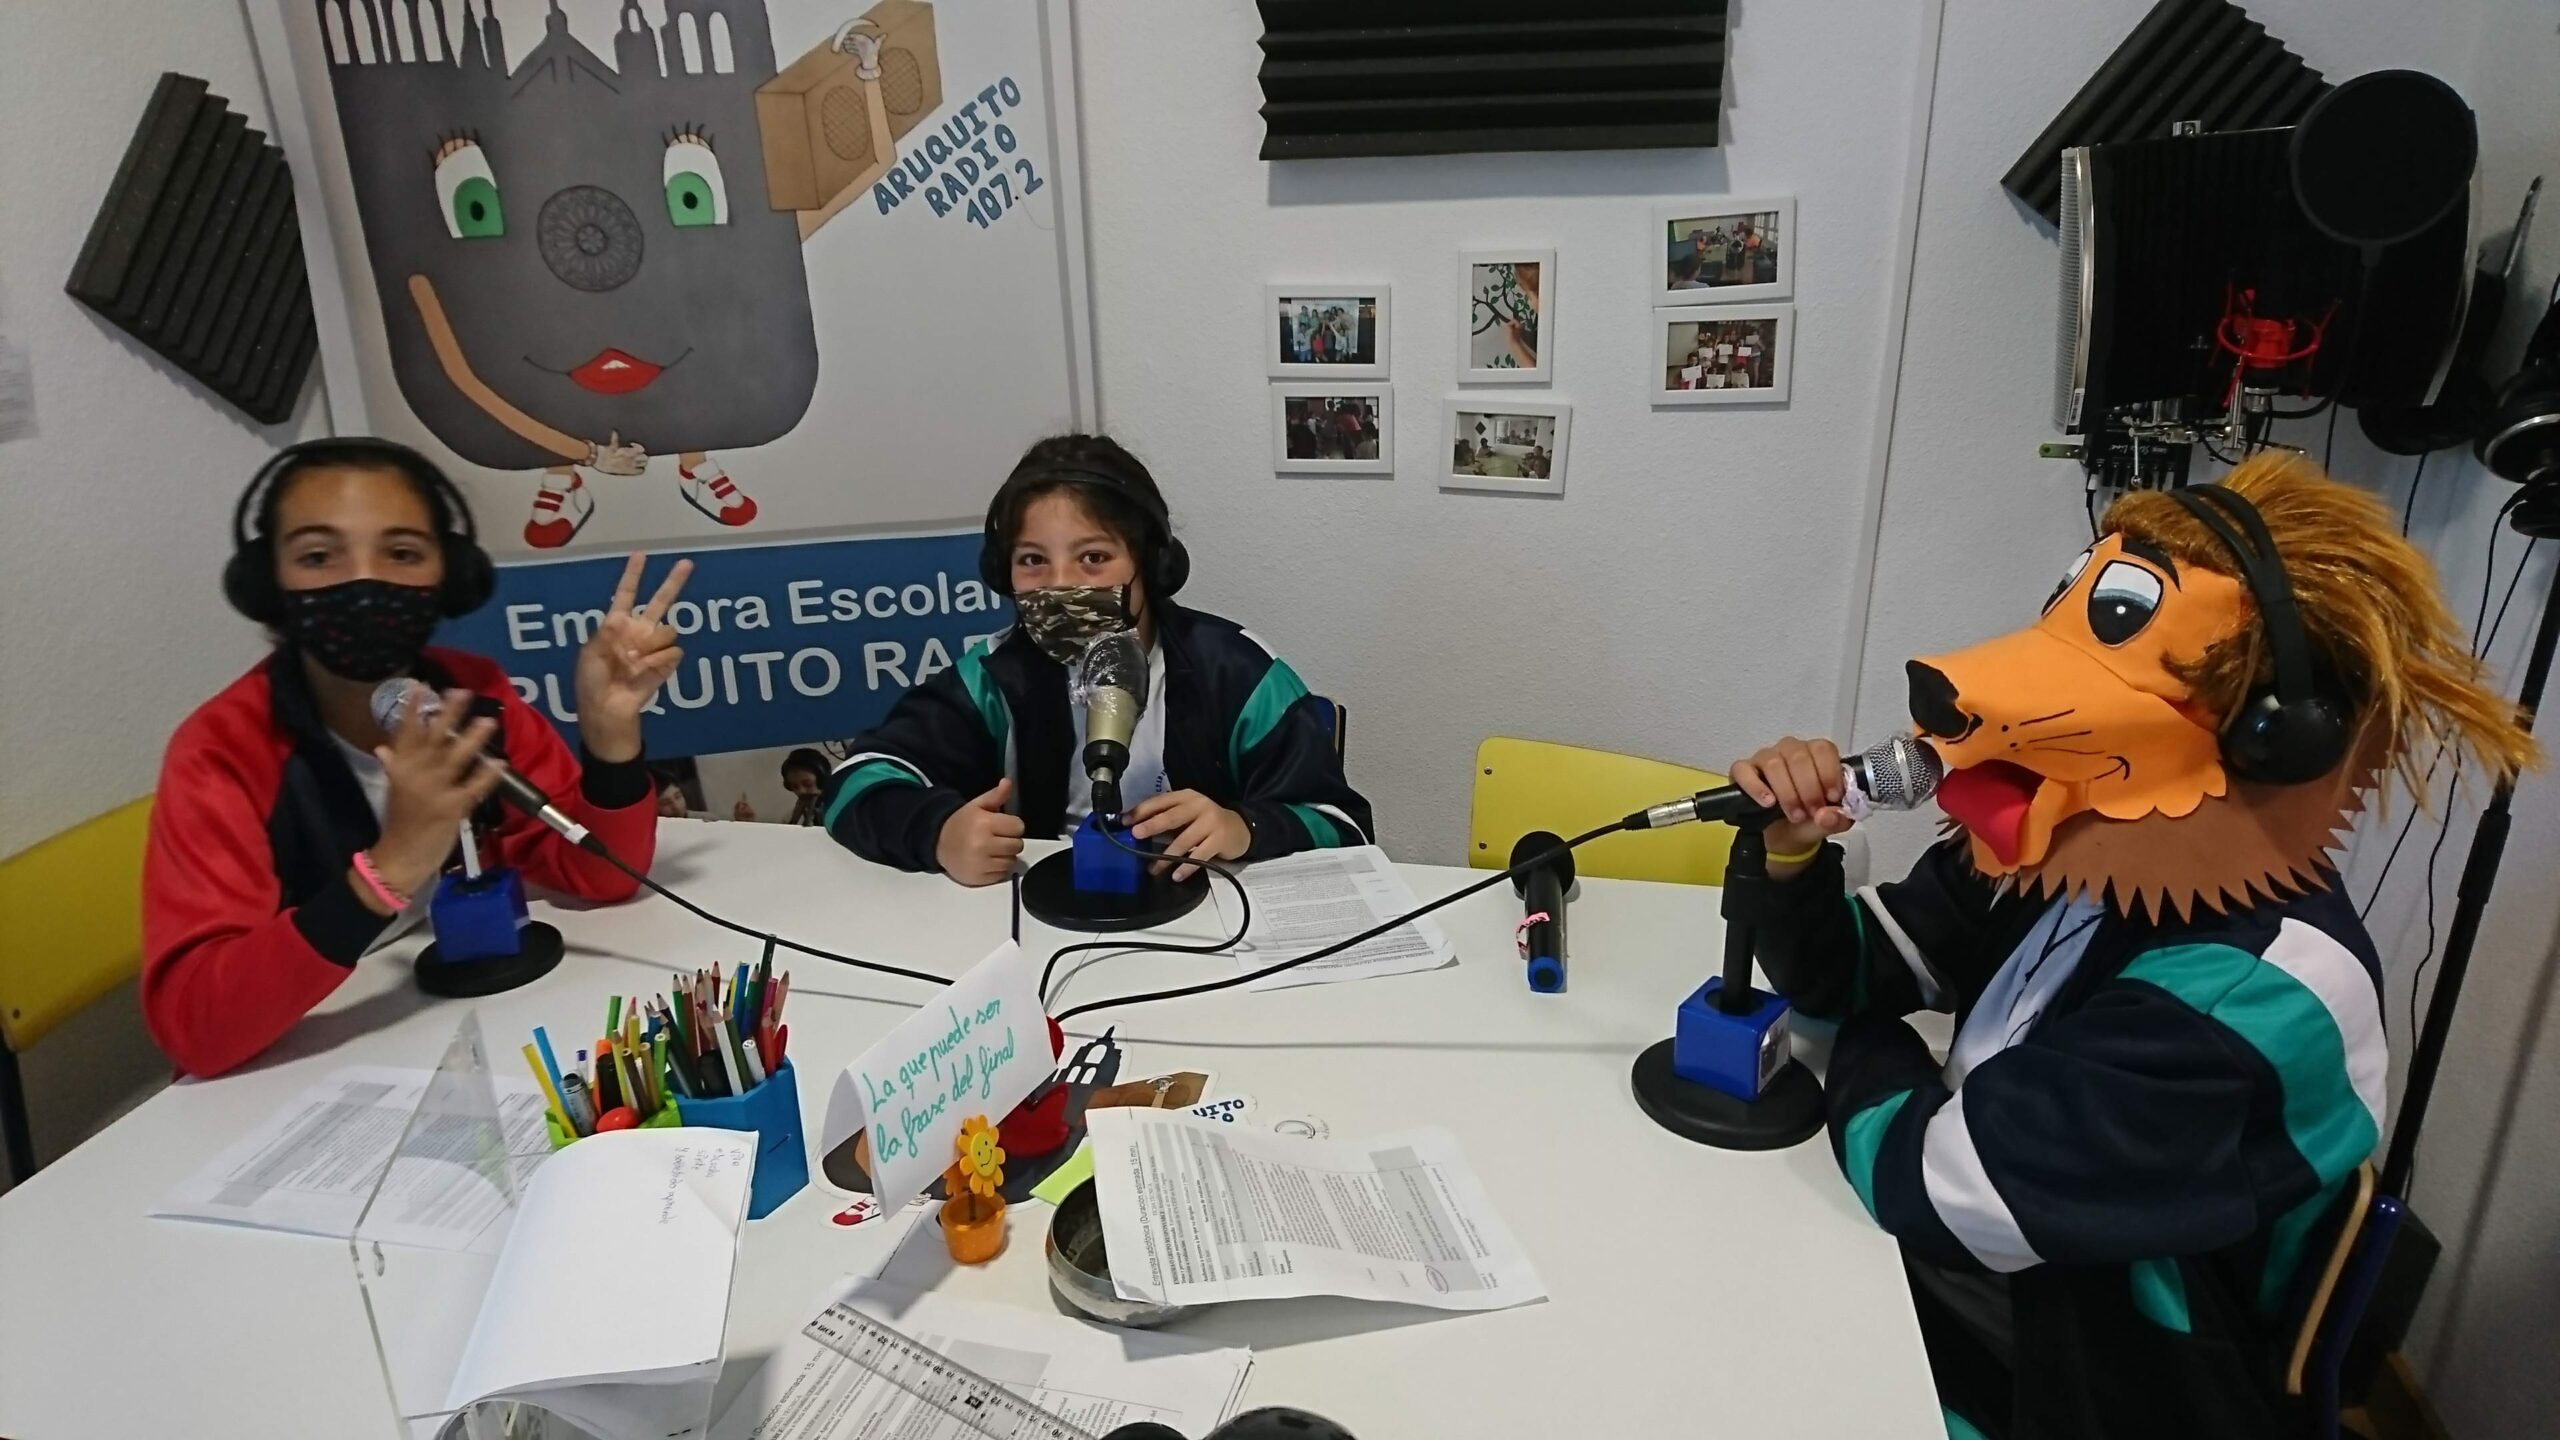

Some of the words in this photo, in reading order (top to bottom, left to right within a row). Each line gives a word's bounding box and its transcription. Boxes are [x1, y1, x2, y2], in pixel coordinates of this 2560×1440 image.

[873, 76, 1021, 215] ARUQUITO
[924, 124, 1017, 218] RADIO
[967, 158, 1044, 229] 107.2
[506, 595, 770, 650] Emora
[862, 1072, 896, 1114] La
[900, 1052, 926, 1100] que
[929, 1005, 971, 1082] puede
[975, 999, 1002, 1025] ser
[876, 1123, 903, 1164] la
[901, 1092, 946, 1158] frase
[952, 1053, 973, 1102] del
[979, 1026, 1015, 1100] final
[1192, 1099, 1245, 1117] UITO
